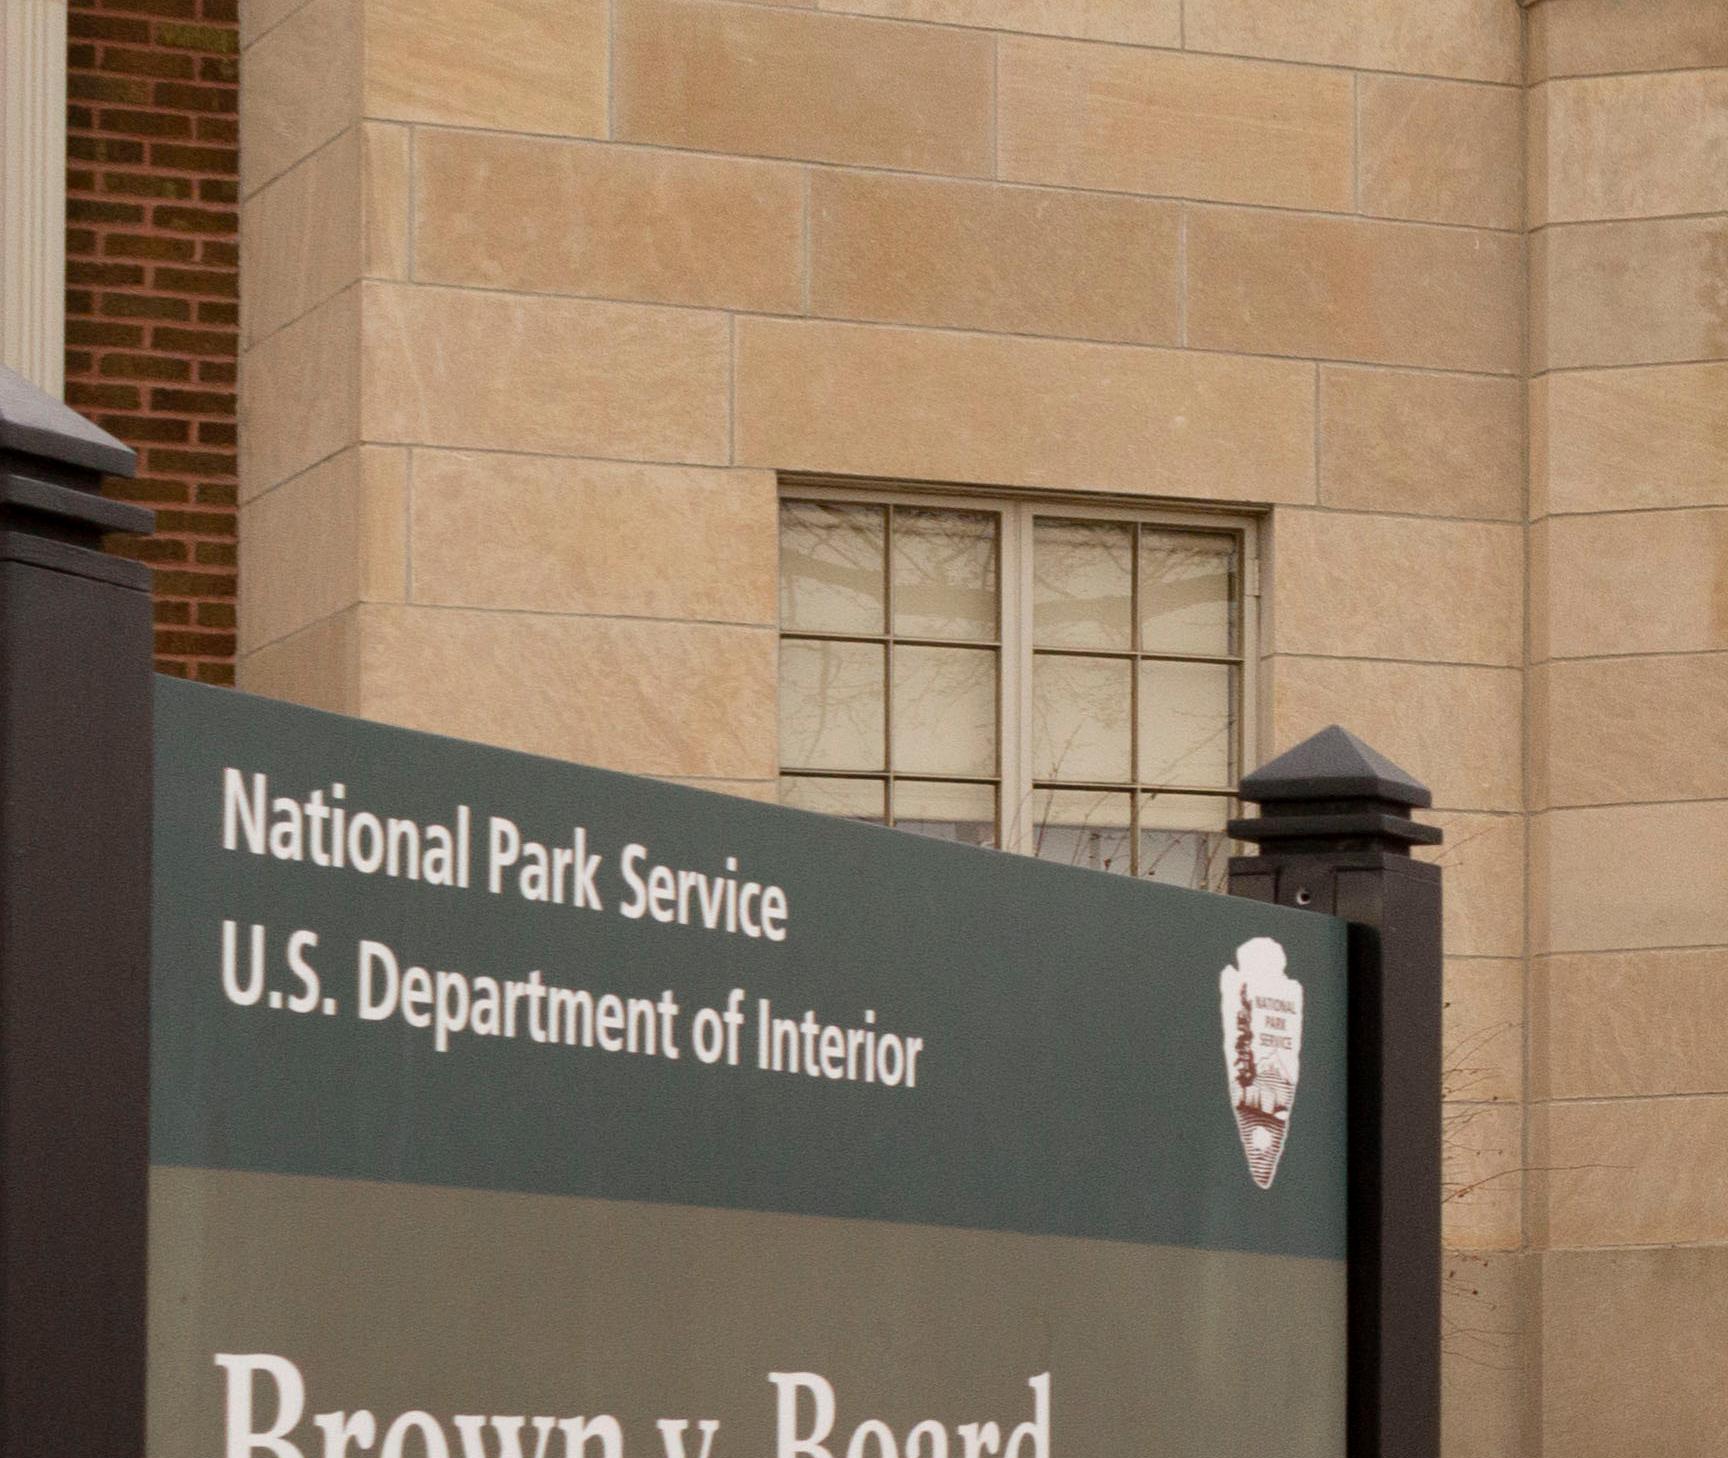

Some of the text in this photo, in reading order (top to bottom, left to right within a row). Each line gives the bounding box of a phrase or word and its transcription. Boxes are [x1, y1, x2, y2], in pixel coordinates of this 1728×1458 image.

[222, 766, 789, 942] National Park Service
[221, 919, 924, 1089] U.S. Department of Interior
[1254, 995, 1297, 1016] NATIONAL
[1264, 1015, 1287, 1032] PARK
[1258, 1032, 1293, 1051] SERVICE
